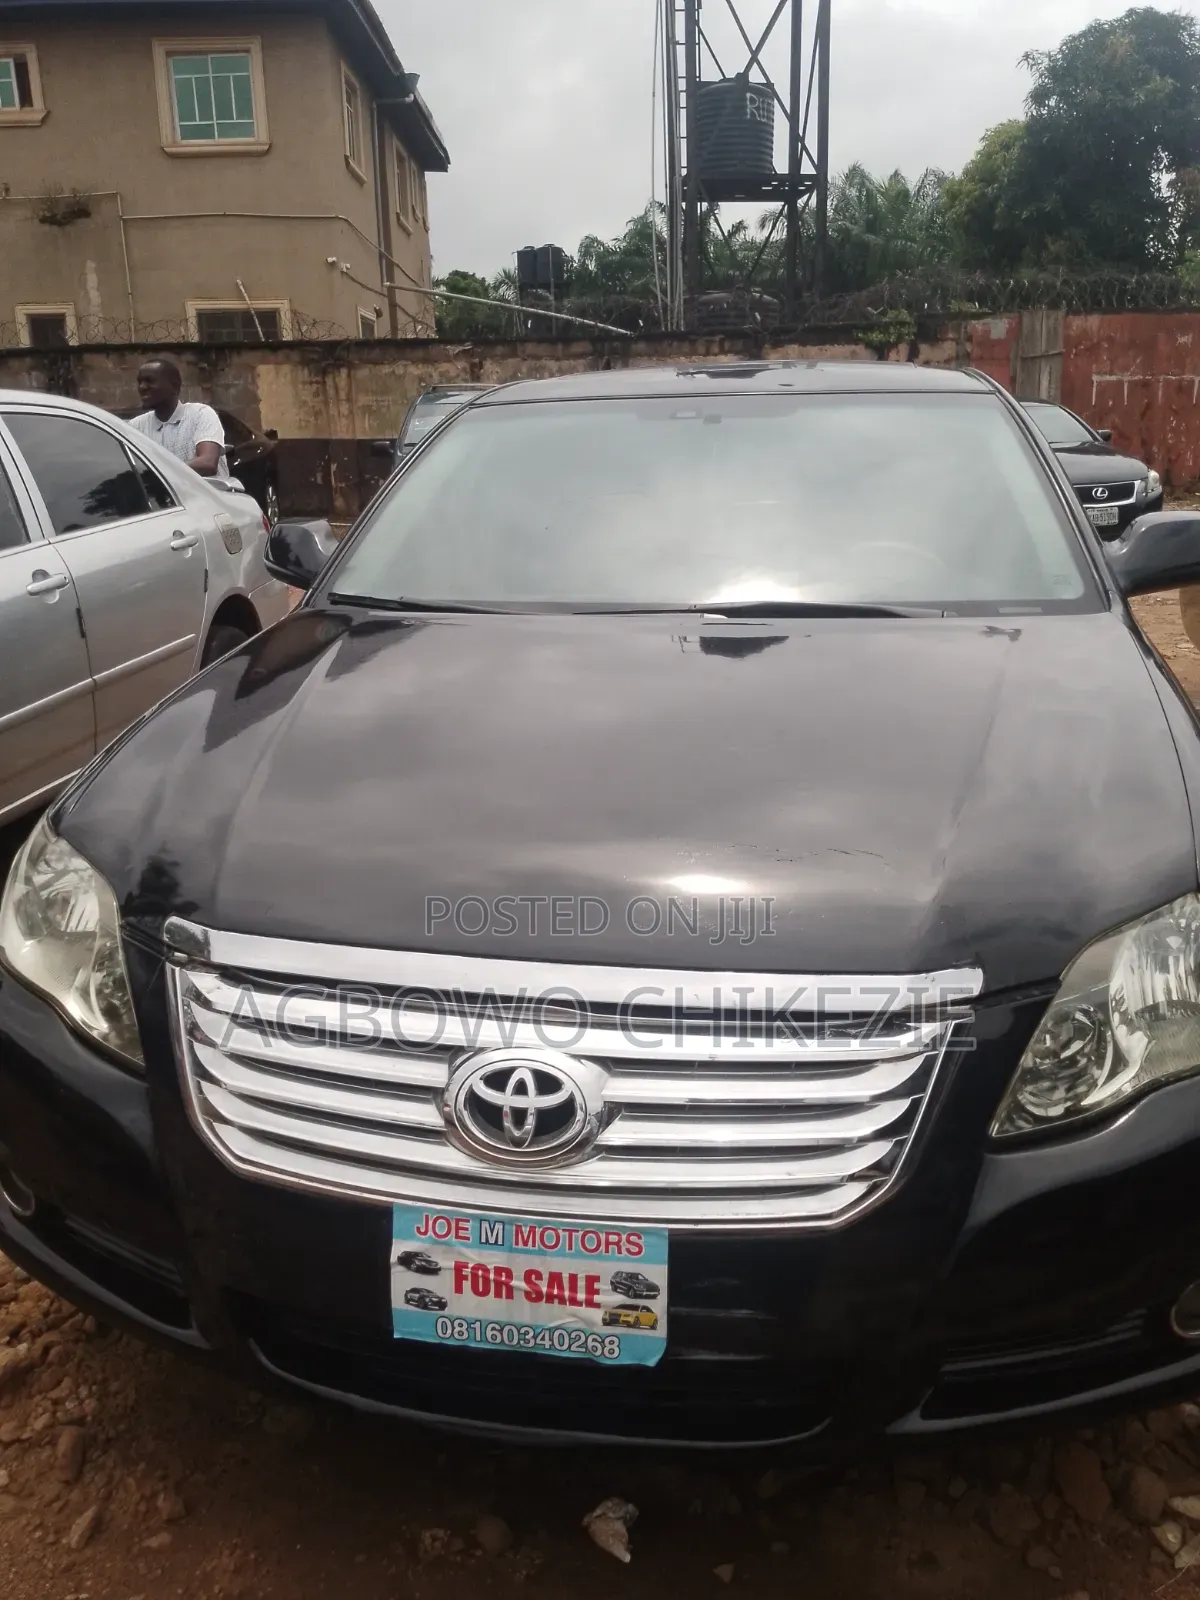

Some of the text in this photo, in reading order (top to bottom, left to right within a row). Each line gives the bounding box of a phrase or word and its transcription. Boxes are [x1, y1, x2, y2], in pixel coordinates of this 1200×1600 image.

[415, 1214, 645, 1257] JOE M MOTORS
[453, 1260, 602, 1309] FOR SALE
[435, 1316, 621, 1360] 08160340268
